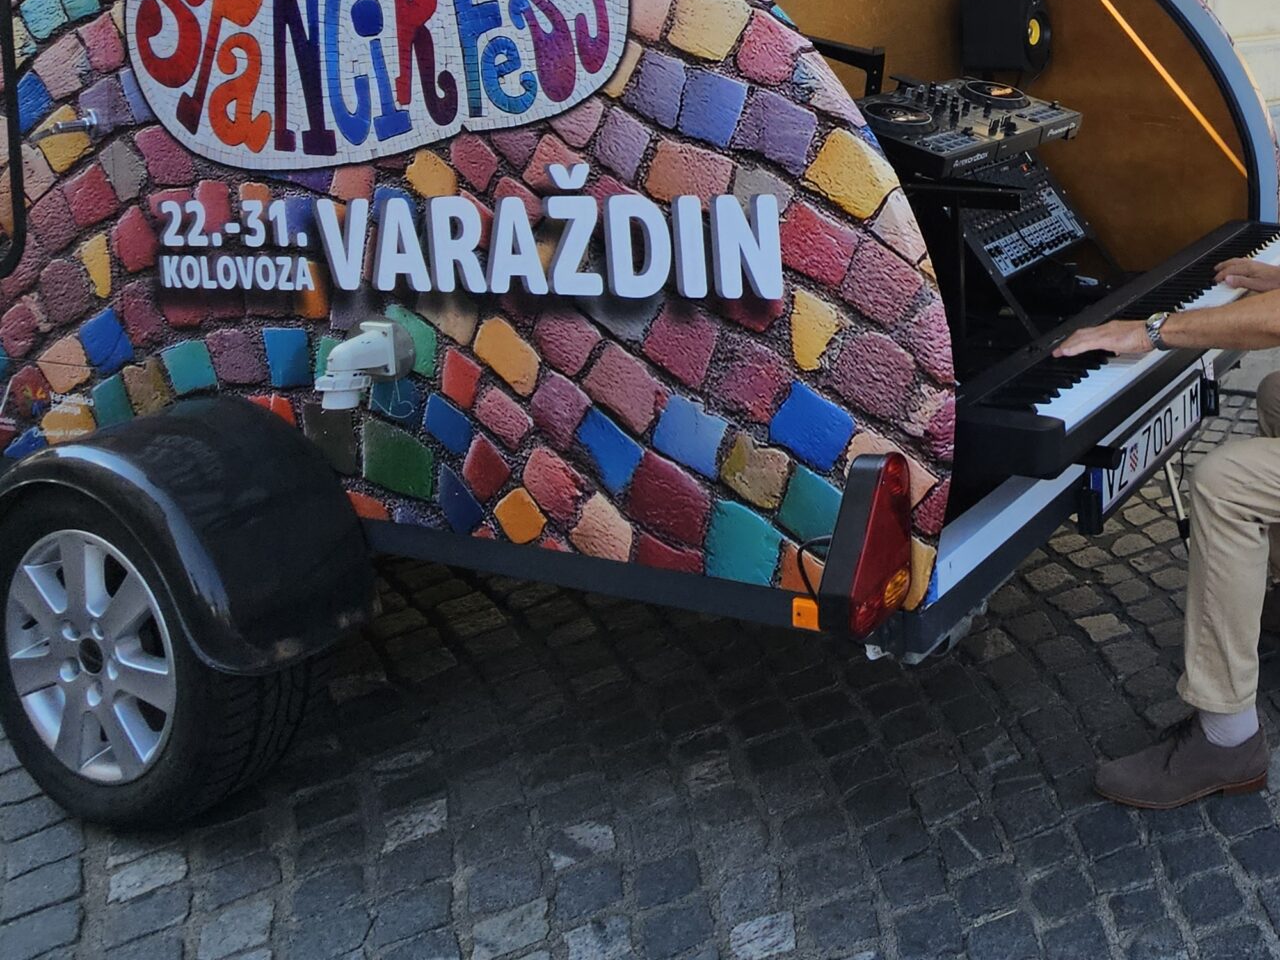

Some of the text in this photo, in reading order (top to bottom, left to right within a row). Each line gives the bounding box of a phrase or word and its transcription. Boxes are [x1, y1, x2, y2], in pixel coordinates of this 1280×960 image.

[159, 196, 309, 249] 22.-31.
[314, 163, 785, 302] VARAŽDIN
[160, 254, 316, 292] KOLOVOZA
